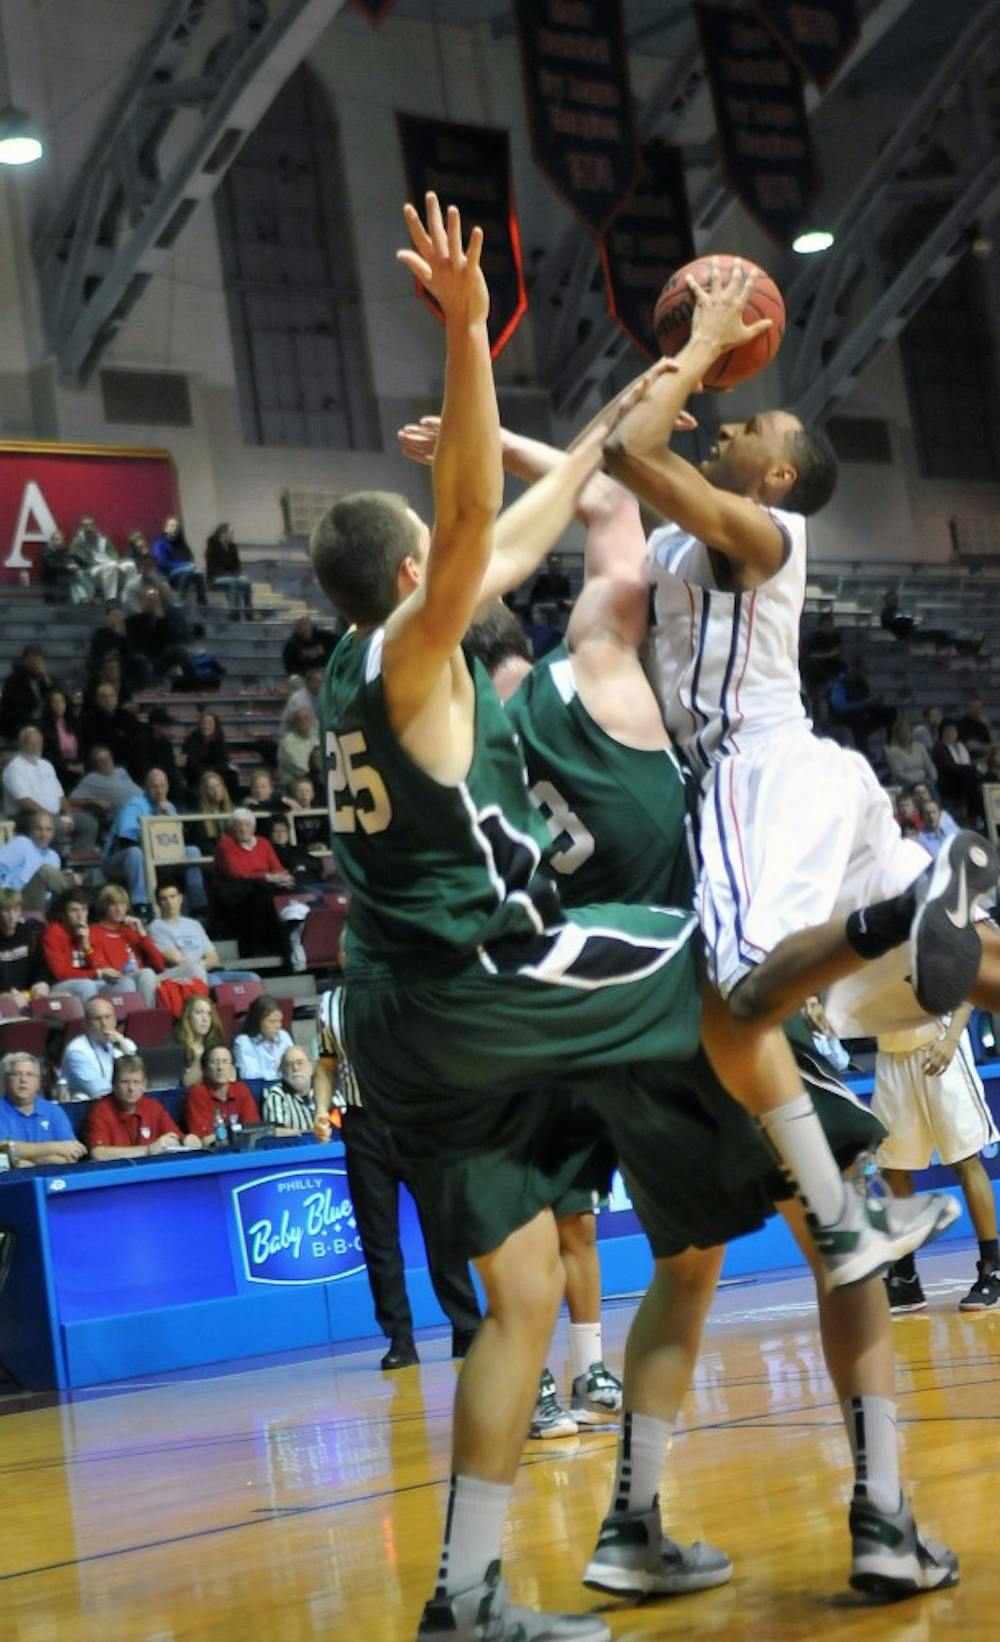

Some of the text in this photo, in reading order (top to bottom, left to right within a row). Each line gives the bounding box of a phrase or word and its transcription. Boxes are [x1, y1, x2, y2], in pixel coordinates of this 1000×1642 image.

[4, 479, 61, 568] A
[326, 729, 393, 835] 25
[277, 1178, 323, 1193] PHILLY
[249, 1209, 304, 1264] Baby
